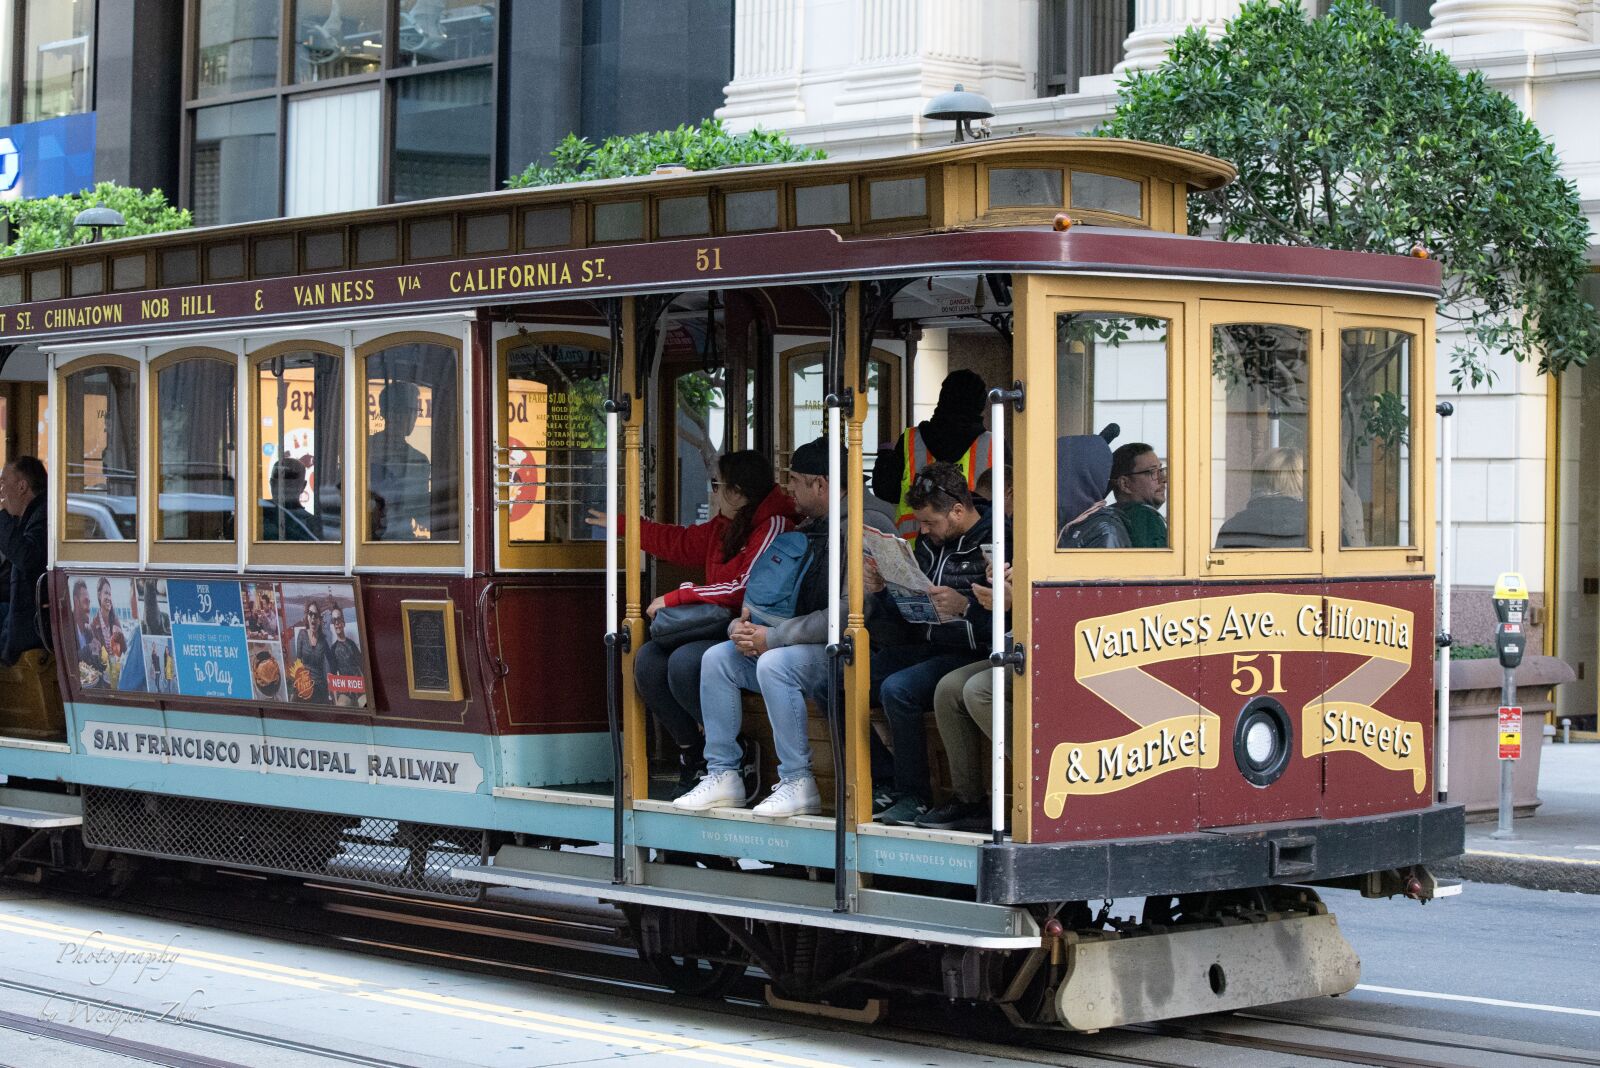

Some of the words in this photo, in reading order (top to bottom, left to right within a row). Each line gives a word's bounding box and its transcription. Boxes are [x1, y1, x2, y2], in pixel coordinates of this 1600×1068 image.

[696, 248, 723, 271] 51
[16, 312, 34, 330] ST.
[44, 304, 122, 328] CHINATOWN
[141, 298, 169, 319] NOB
[181, 295, 216, 316] HILL
[294, 284, 325, 306] VAN
[331, 280, 374, 303] NESS
[450, 262, 572, 293] CALIFORNIA
[581, 258, 612, 282] ST.
[196, 584, 210, 594] PIER
[197, 594, 212, 613] 39
[1081, 624, 1138, 662] Van
[1140, 612, 1213, 653] Ness
[1297, 604, 1410, 650] California
[183, 644, 206, 657] MEETS
[207, 645, 222, 658] THE
[223, 646, 239, 659] BAY
[205, 660, 233, 695] Play
[332, 679, 346, 688] NEW
[347, 681, 363, 689] RIDE!
[1230, 653, 1288, 696] 51
[1323, 708, 1414, 758] Streets
[93, 728, 130, 752] SAN
[135, 733, 241, 764] FRANCISCO
[250, 739, 357, 774] MUNICIPAL
[368, 754, 460, 784] RAILWAY
[1066, 742, 1090, 784] &
[1095, 722, 1208, 784] Market
[702, 831, 720, 841] TWO
[724, 833, 764, 845] STANDEES
[767, 838, 790, 848] ONLY
[874, 849, 895, 860] TWO
[899, 852, 945, 866] STANDEES
[949, 857, 974, 869] ONLY
